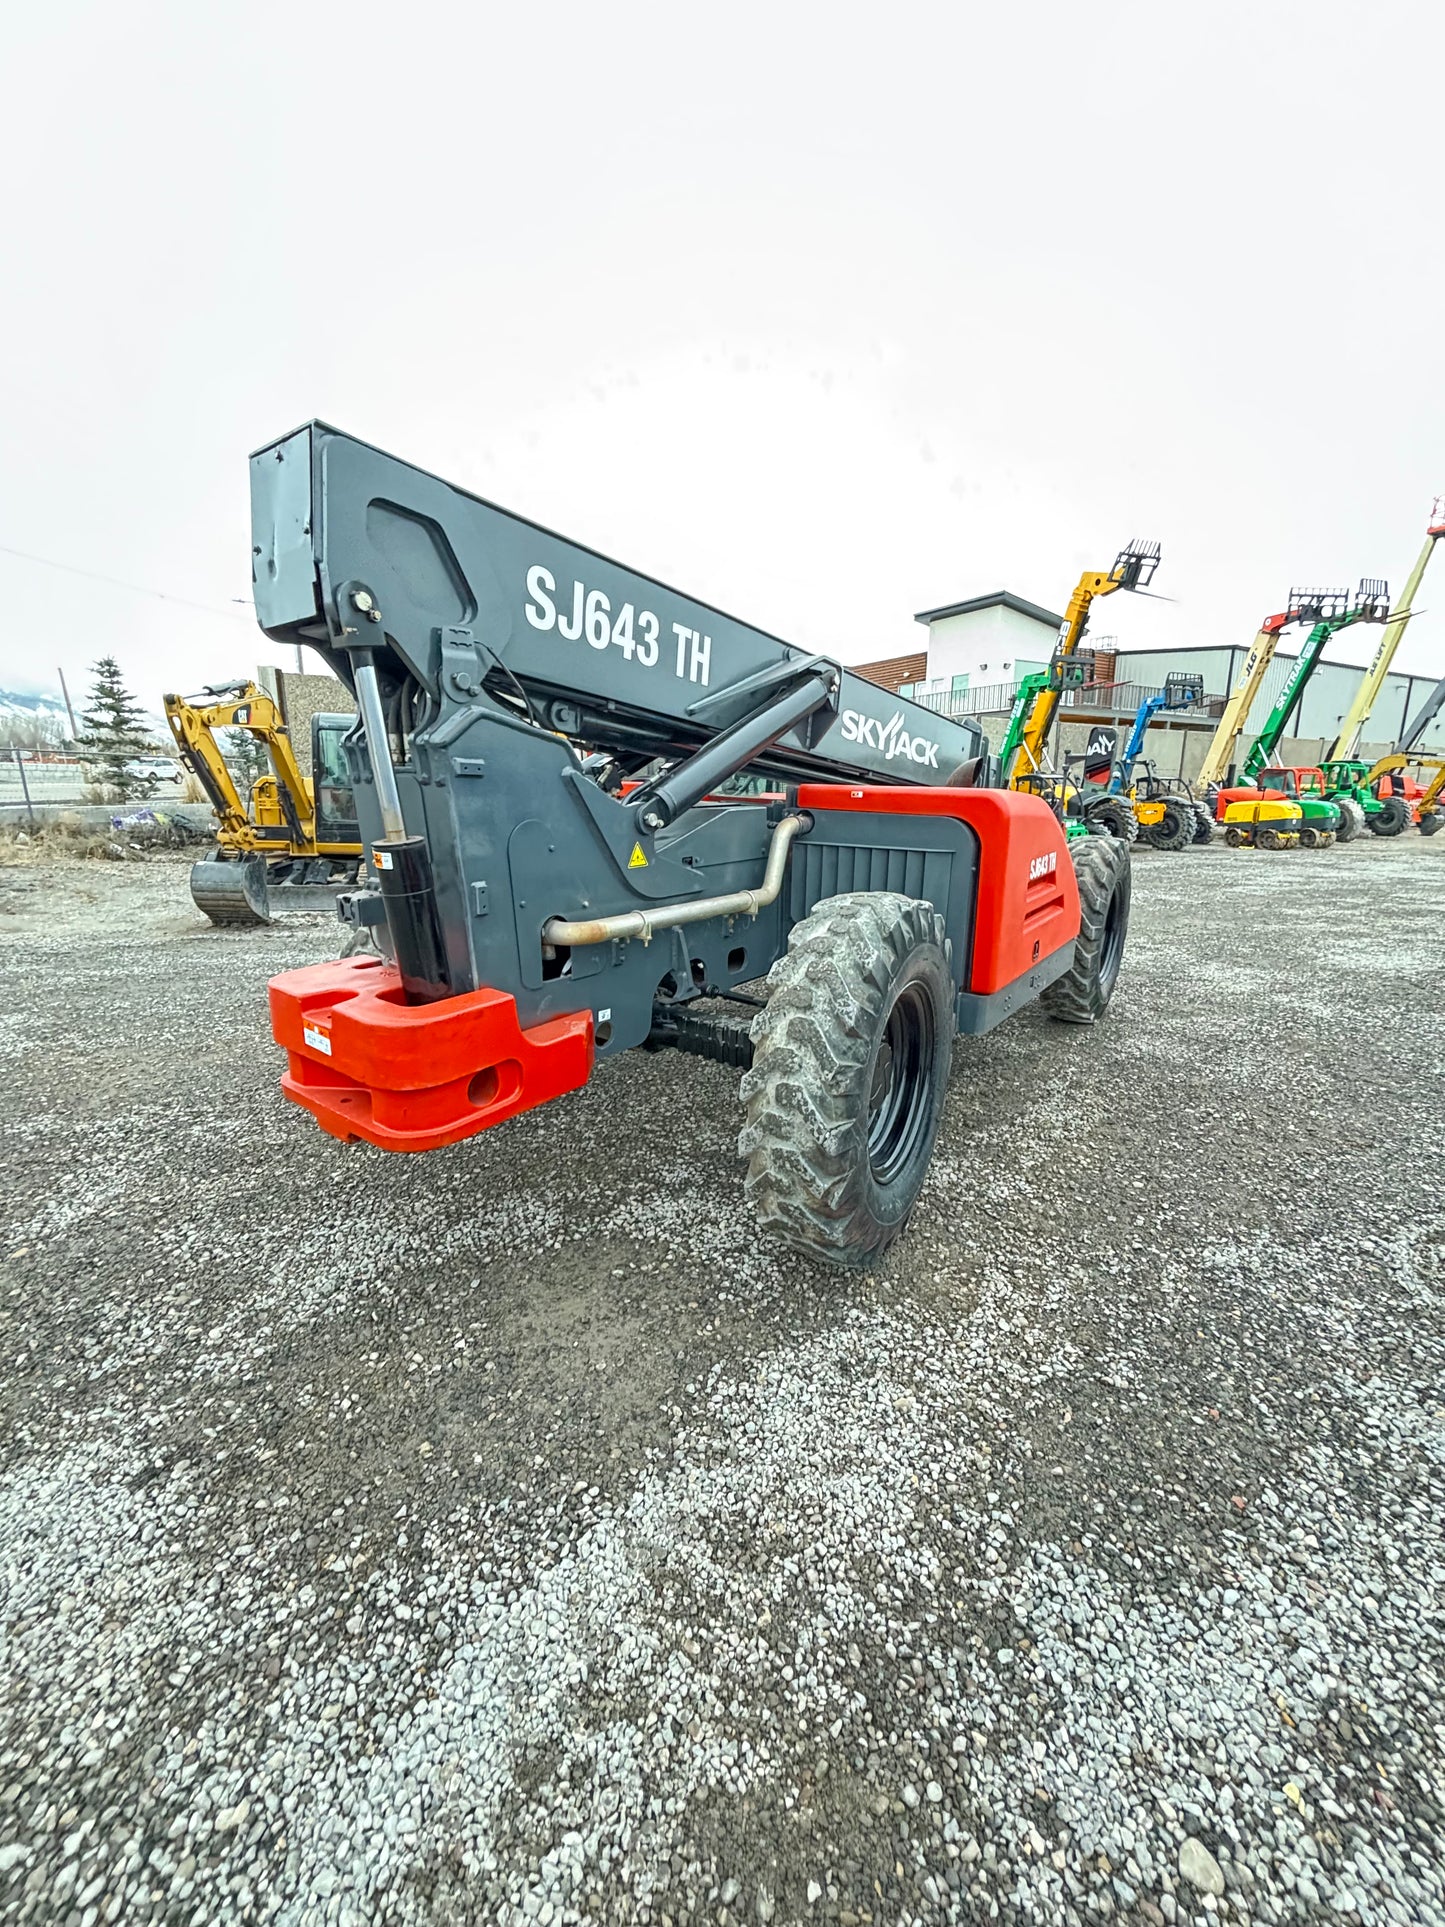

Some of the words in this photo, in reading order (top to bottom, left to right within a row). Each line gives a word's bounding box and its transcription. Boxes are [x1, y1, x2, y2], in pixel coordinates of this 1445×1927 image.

[525, 564, 660, 668] SJ643
[672, 622, 712, 687] TH
[1246, 651, 1258, 678] JLG
[1275, 655, 1307, 711] SKYTRAK
[238, 710, 248, 724] CAT
[841, 709, 939, 769] SKYJACK
[1030, 854, 1048, 880] SJ643
[1048, 851, 1057, 872] TH
